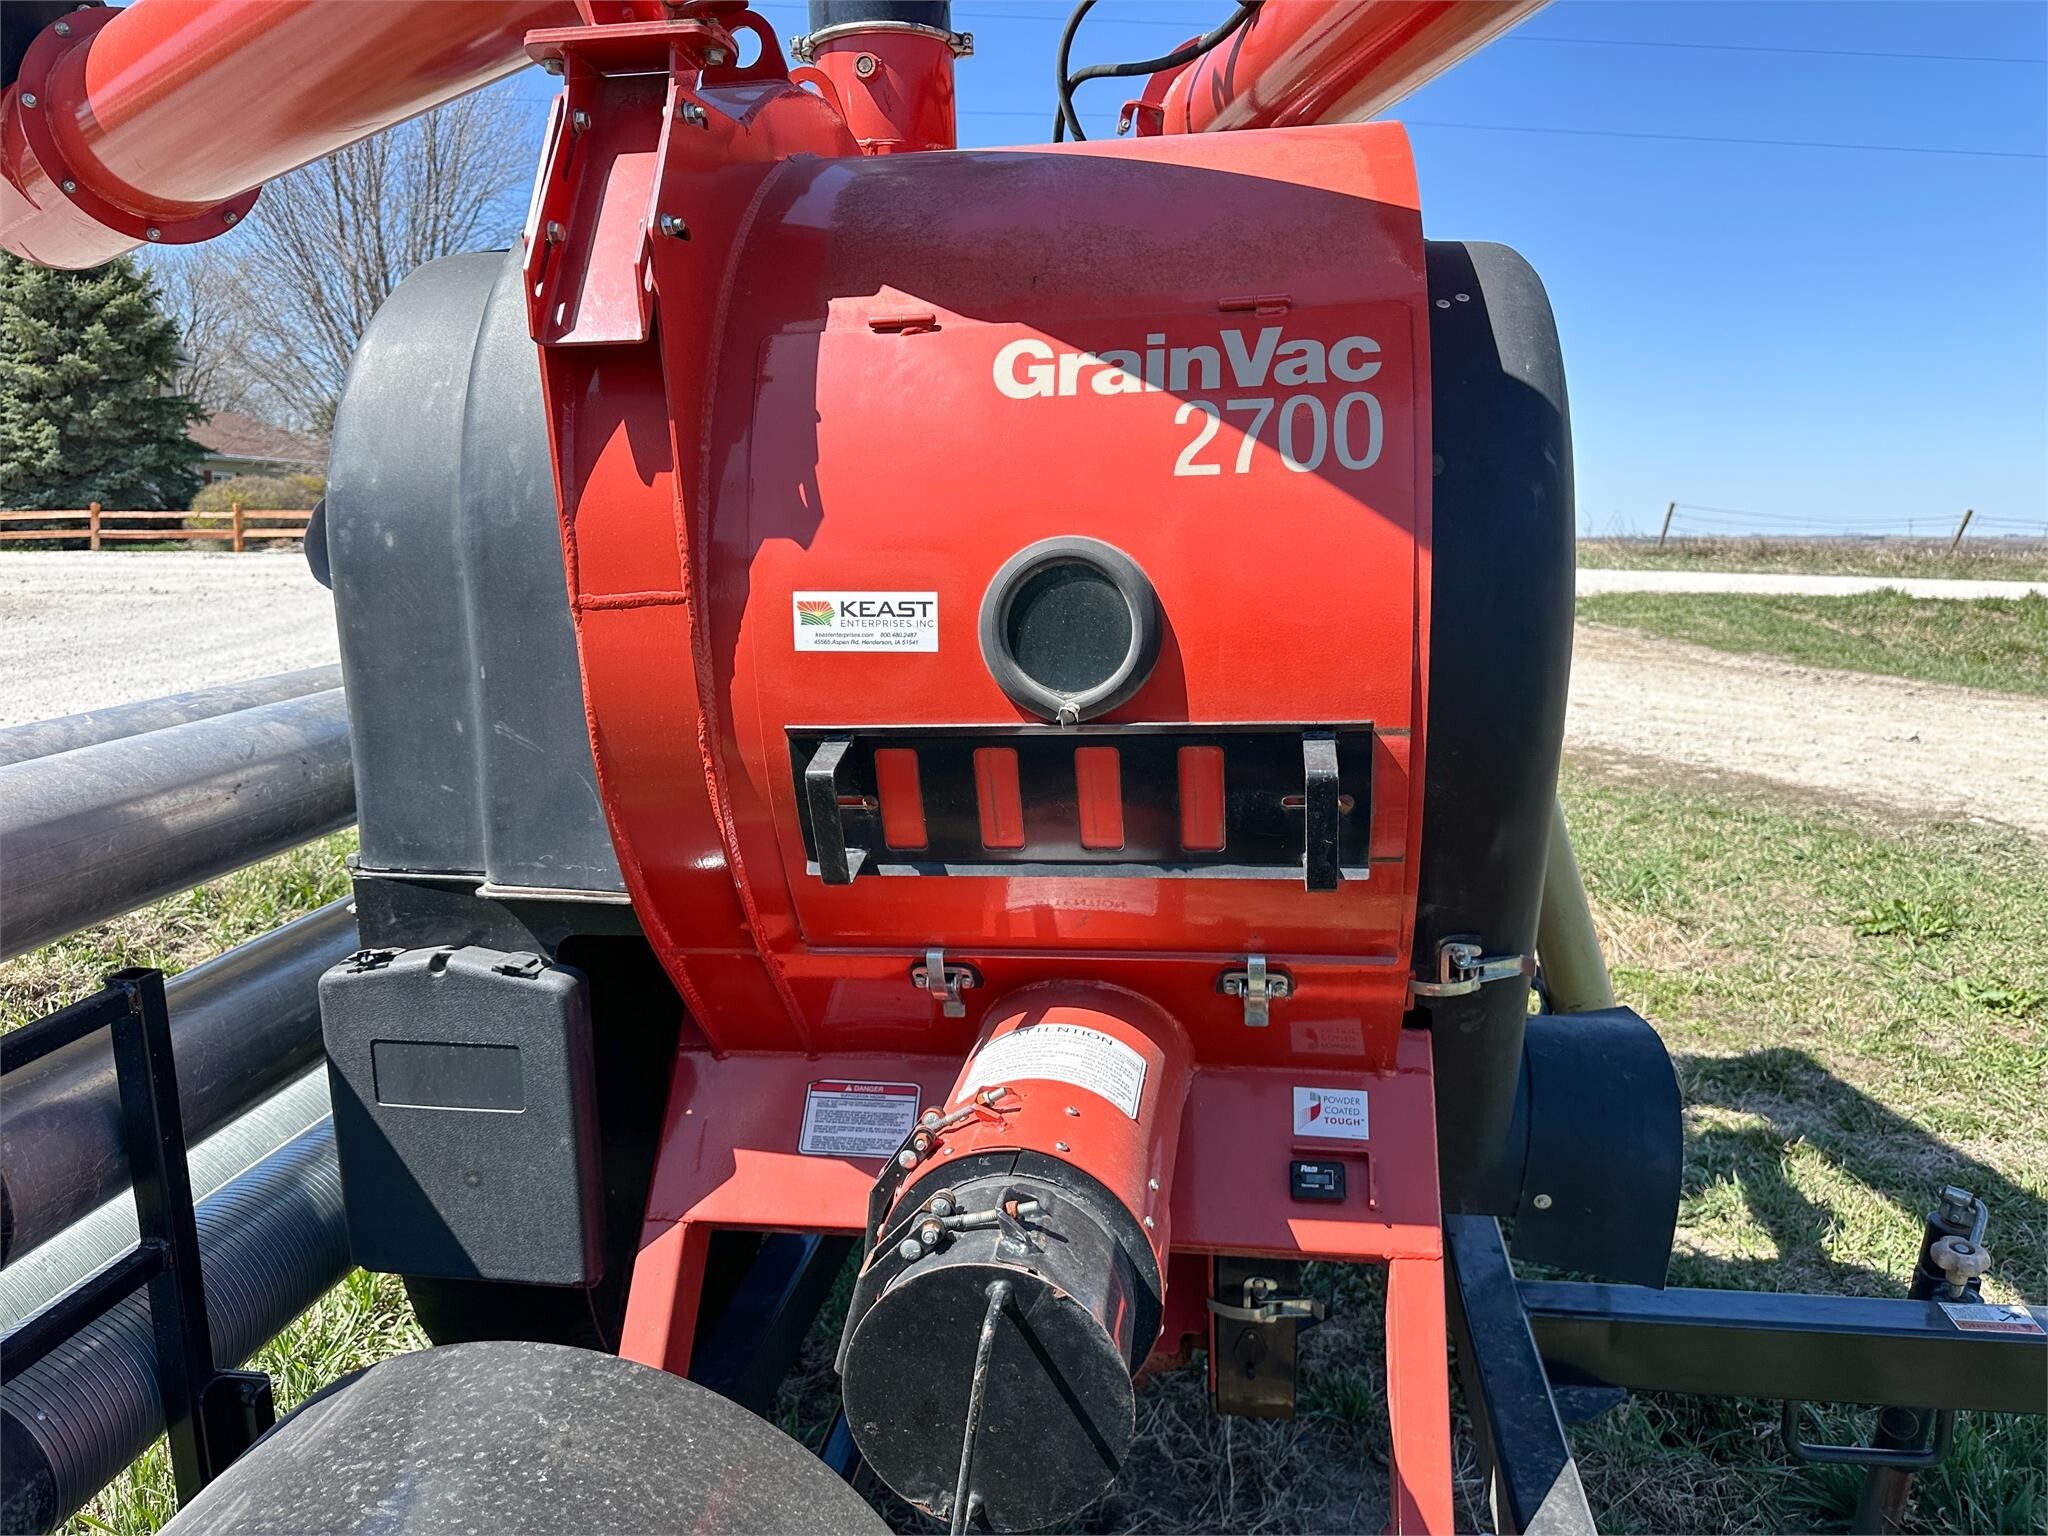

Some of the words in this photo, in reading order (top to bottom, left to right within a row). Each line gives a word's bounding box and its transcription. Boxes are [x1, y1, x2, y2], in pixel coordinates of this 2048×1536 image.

[992, 326, 1383, 400] GrainVac
[1173, 391, 1384, 477] 2700
[840, 601, 934, 618] KEAST
[840, 620, 912, 628] ENTERPRISES
[916, 620, 934, 628] INC
[1012, 1026, 1113, 1046] ATTENTION
[853, 1085, 884, 1093] DANGER
[1323, 1095, 1361, 1106] POWDER
[1324, 1106, 1360, 1116] COATED
